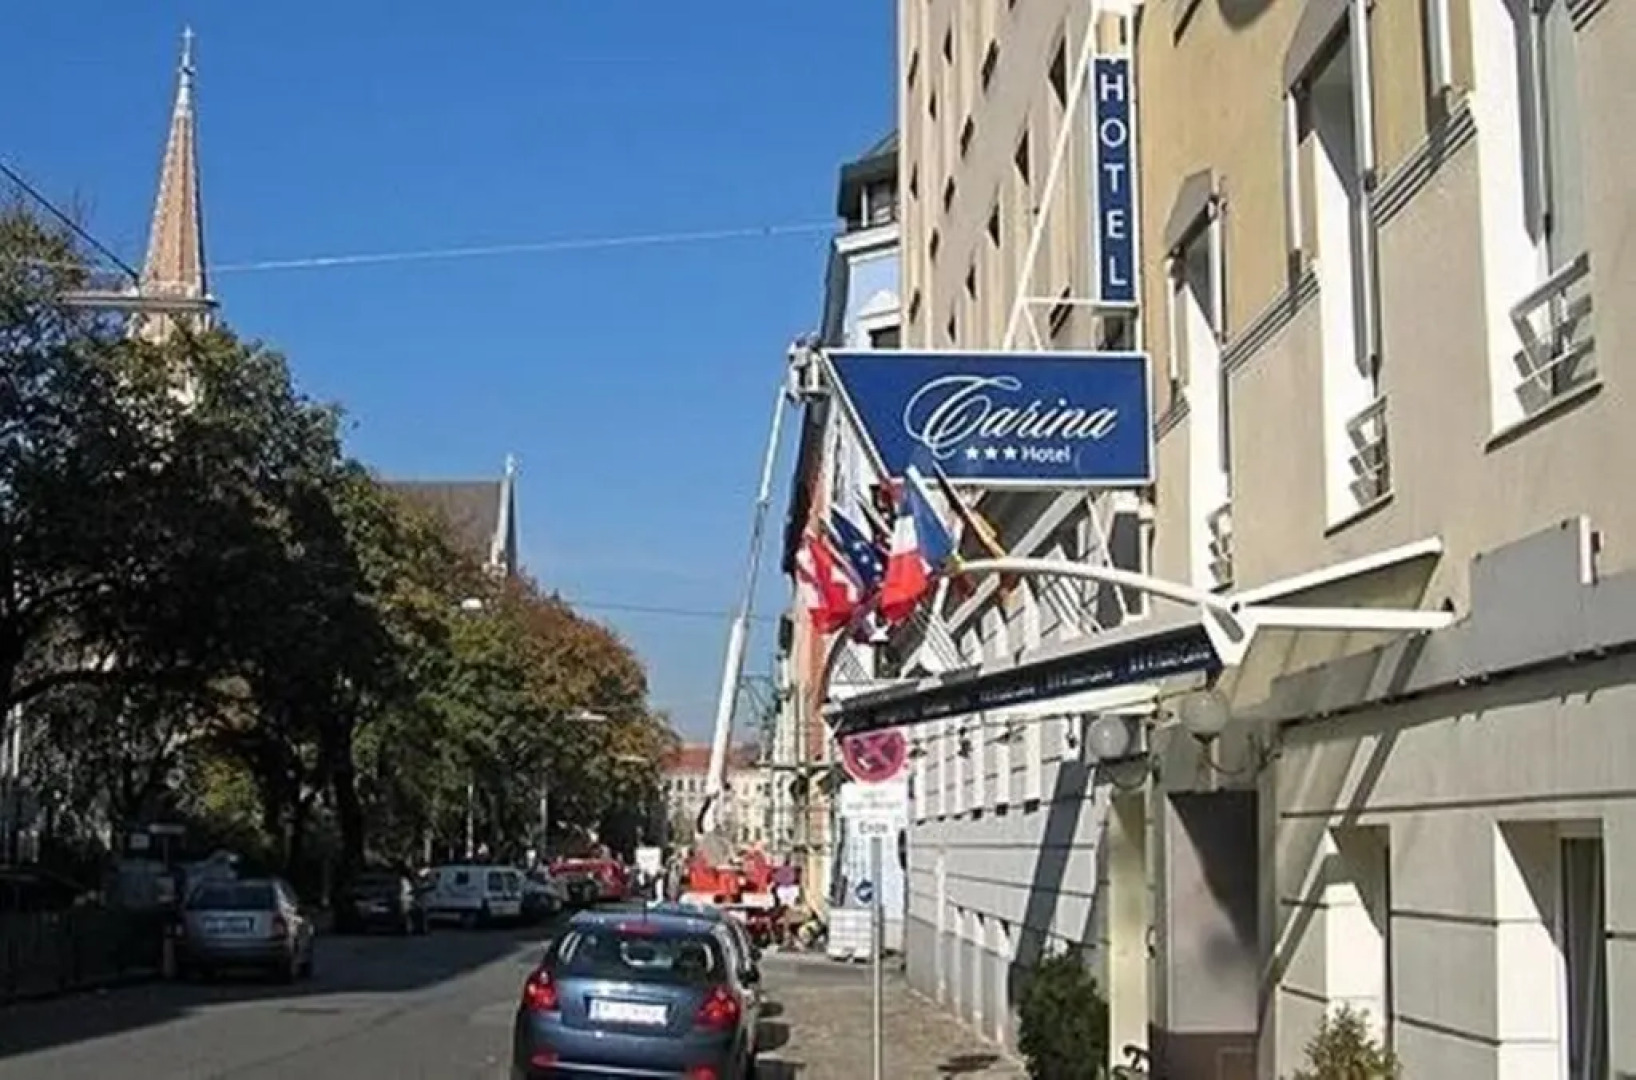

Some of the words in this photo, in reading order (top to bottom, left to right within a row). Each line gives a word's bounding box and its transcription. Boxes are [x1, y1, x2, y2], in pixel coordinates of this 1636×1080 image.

[1100, 74, 1127, 286] HOTEL
[904, 376, 1119, 459] Carina
[1021, 445, 1071, 463] Hotel
